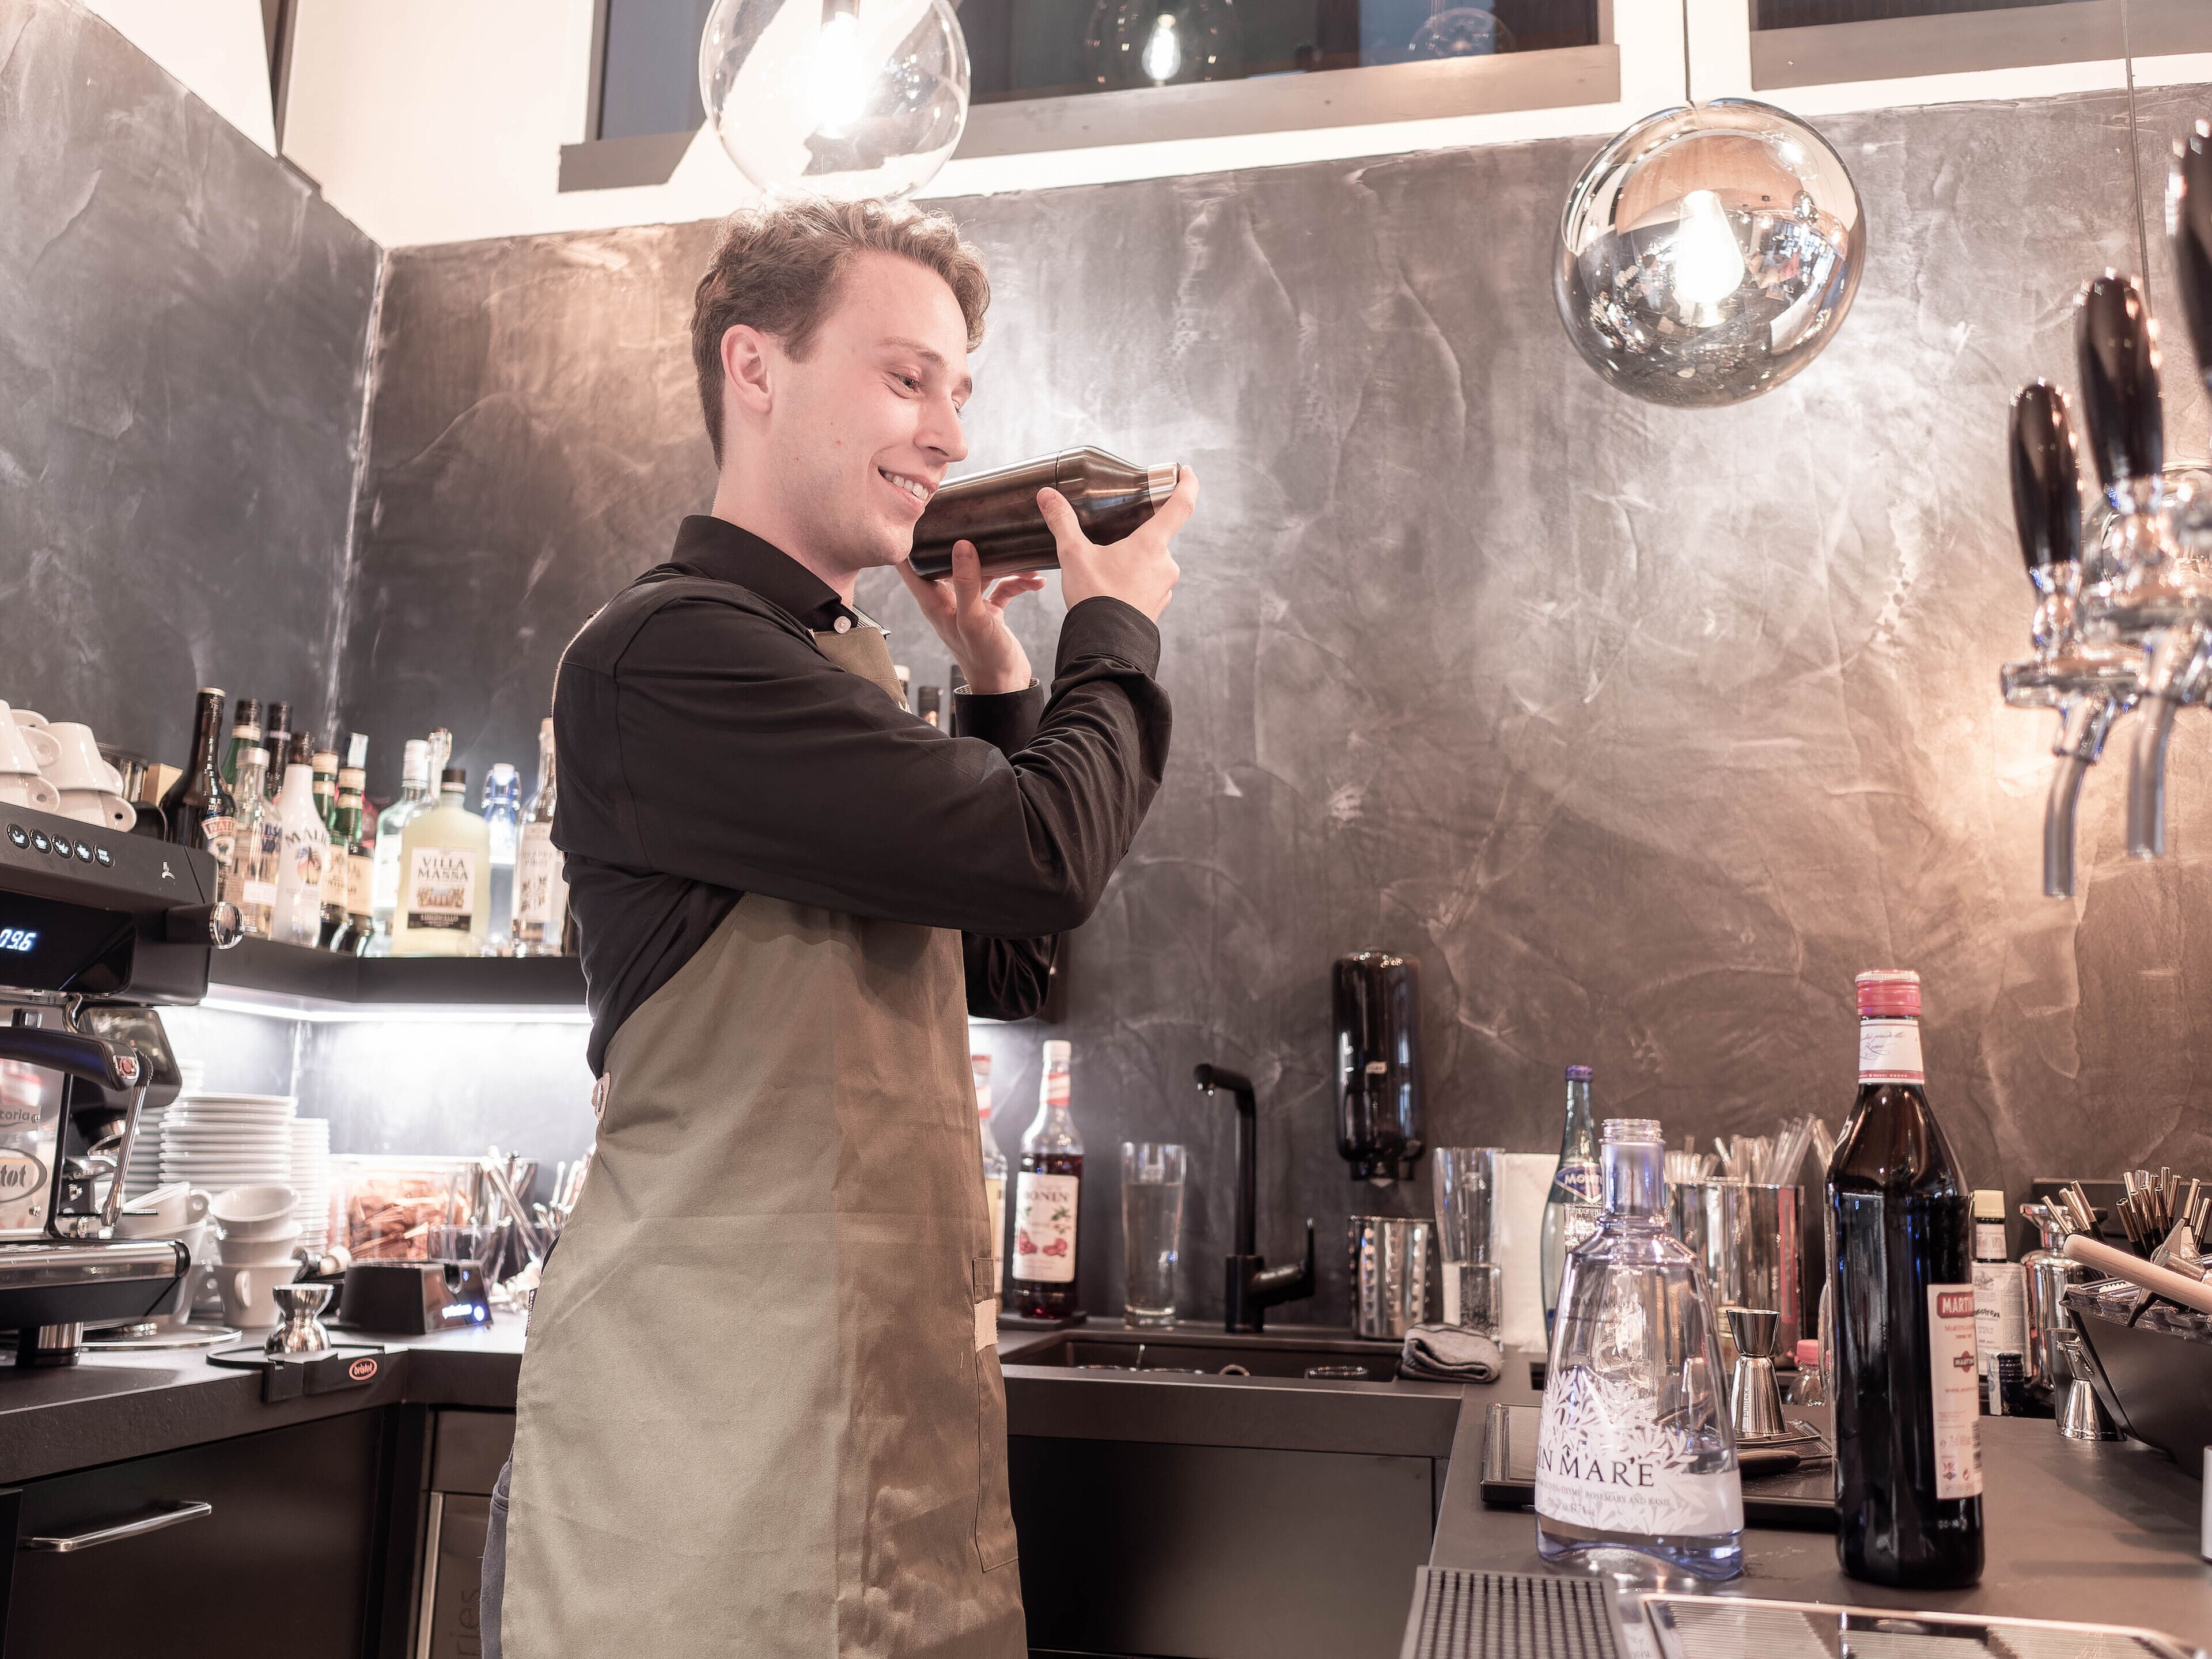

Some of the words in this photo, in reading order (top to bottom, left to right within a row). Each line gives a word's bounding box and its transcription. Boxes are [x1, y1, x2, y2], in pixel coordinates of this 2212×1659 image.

[422, 856, 464, 869] VILLA
[417, 868, 468, 881] MASSA
[1559, 1453, 1654, 1487] MARE
[1628, 1496, 1646, 1505] AND
